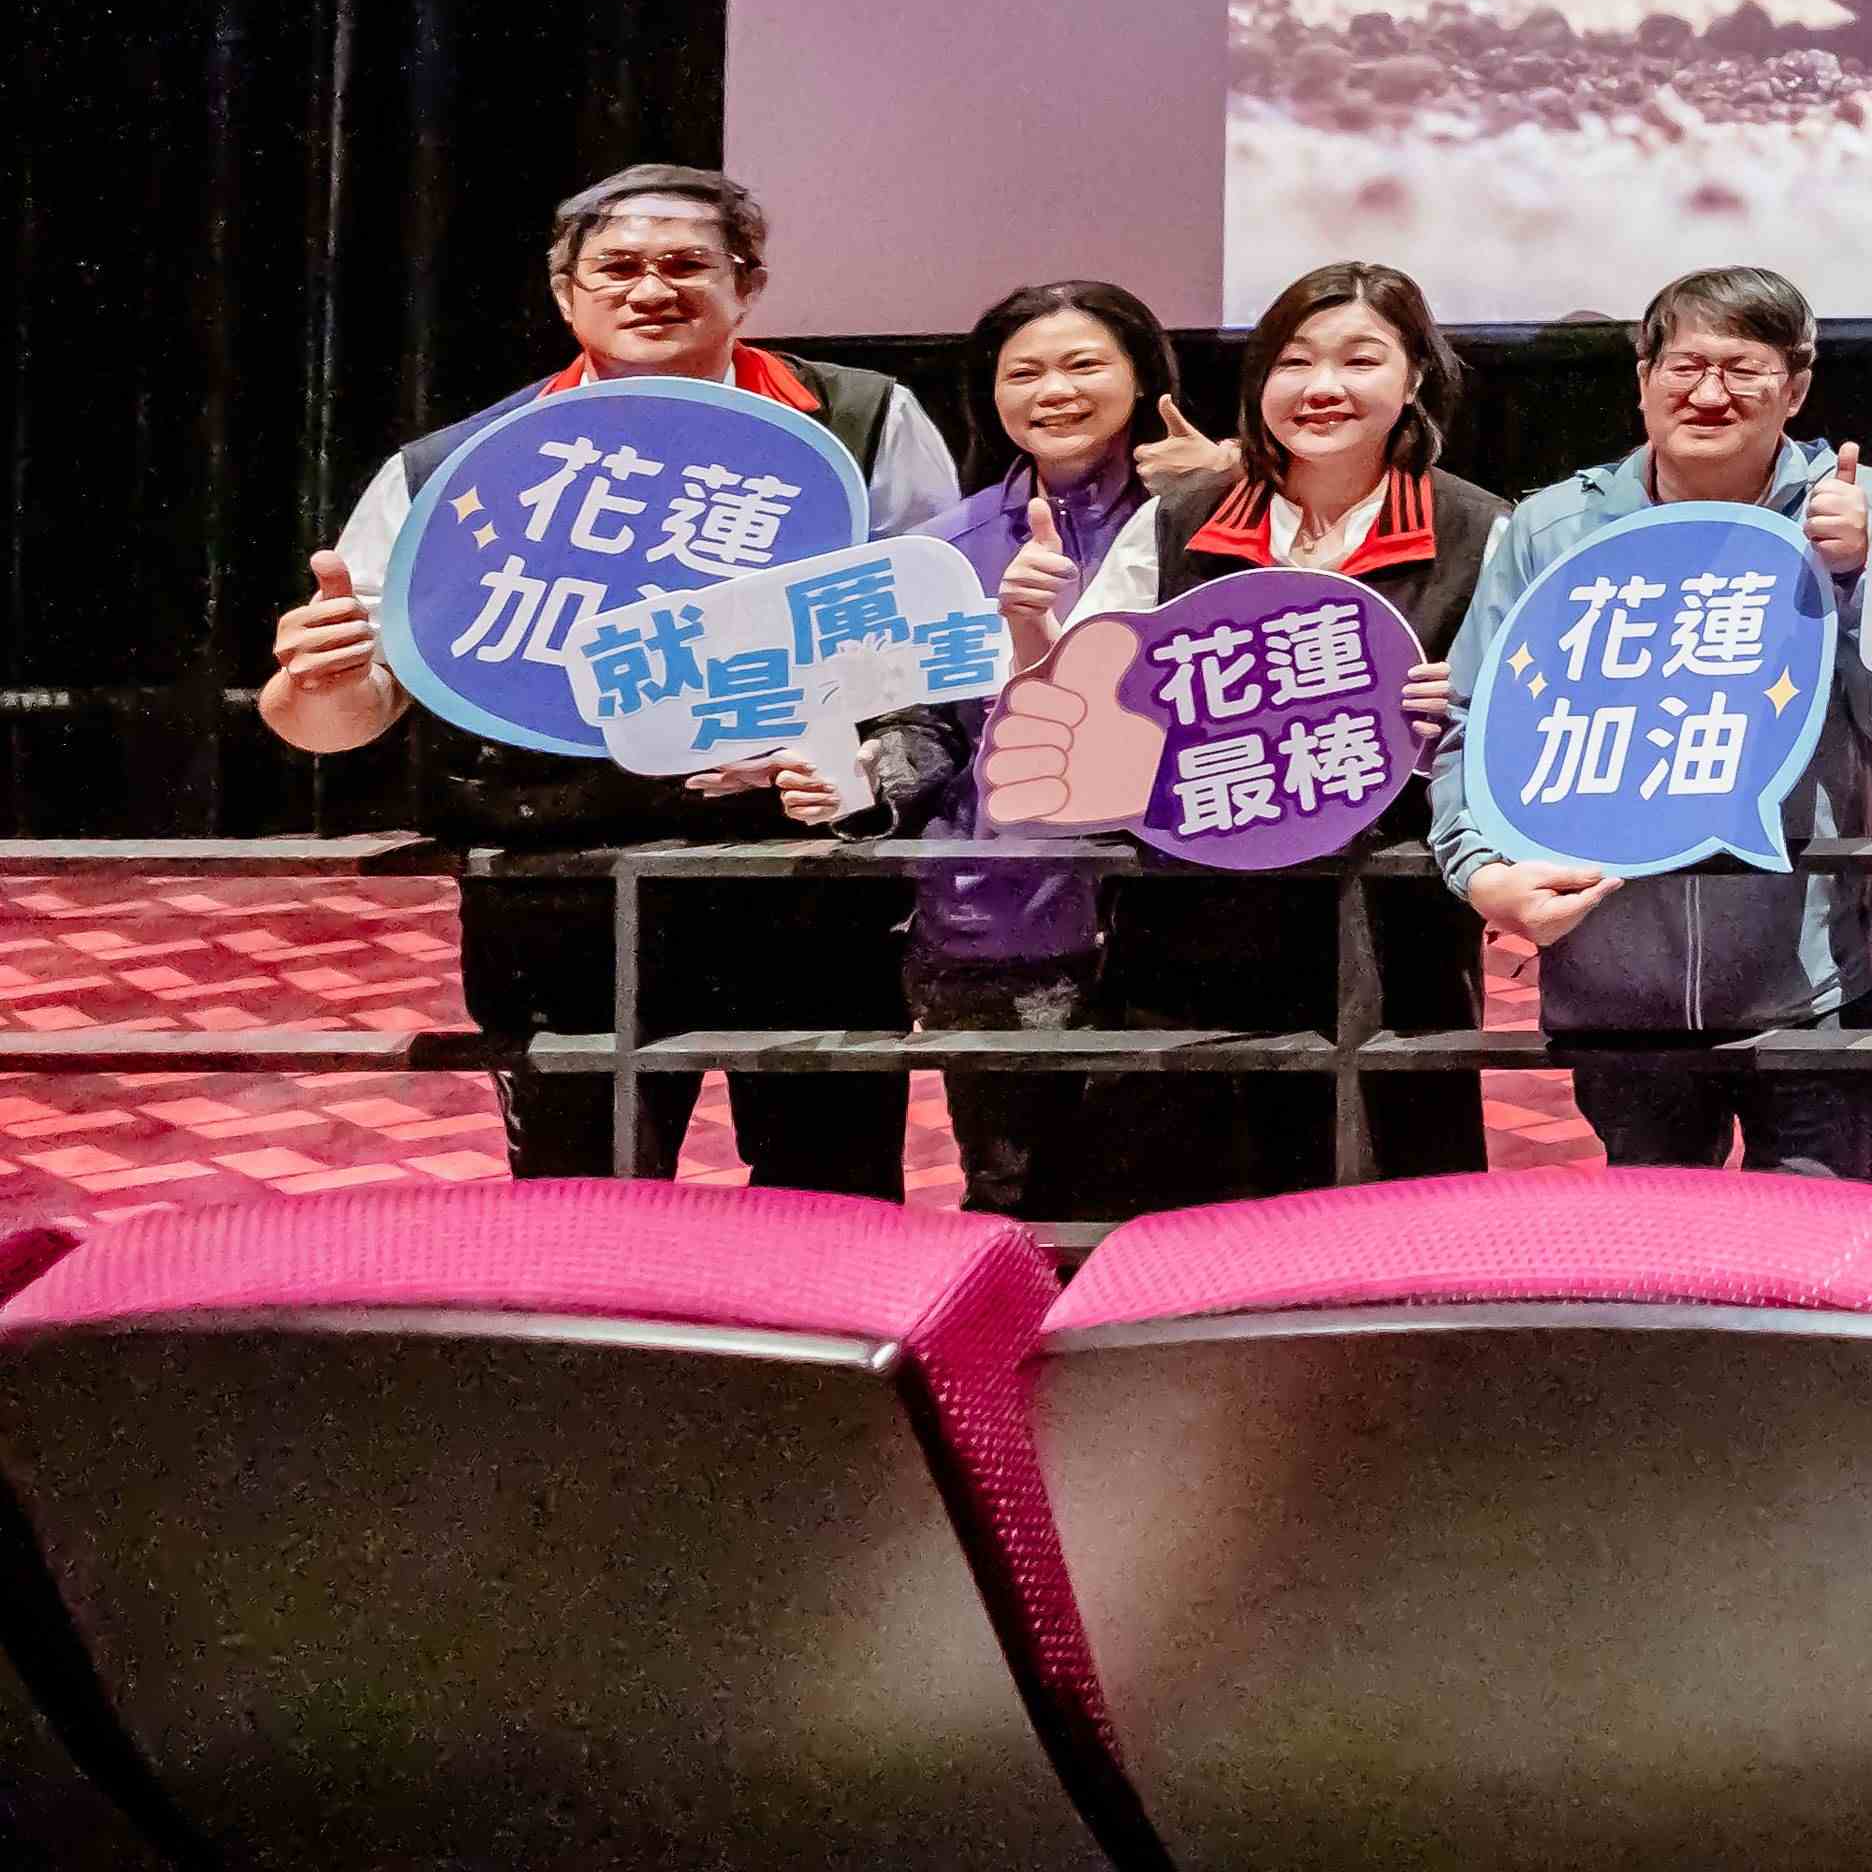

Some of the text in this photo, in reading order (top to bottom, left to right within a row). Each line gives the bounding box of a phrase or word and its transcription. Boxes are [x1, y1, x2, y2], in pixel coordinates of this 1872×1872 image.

[517, 436, 801, 580] 花蓮
[580, 556, 1002, 750] 就是厲害
[1152, 603, 1371, 726] 花蓮
[1556, 571, 1778, 682] 花蓮
[1174, 713, 1387, 838] 最棒
[1521, 691, 1750, 806] 加油
